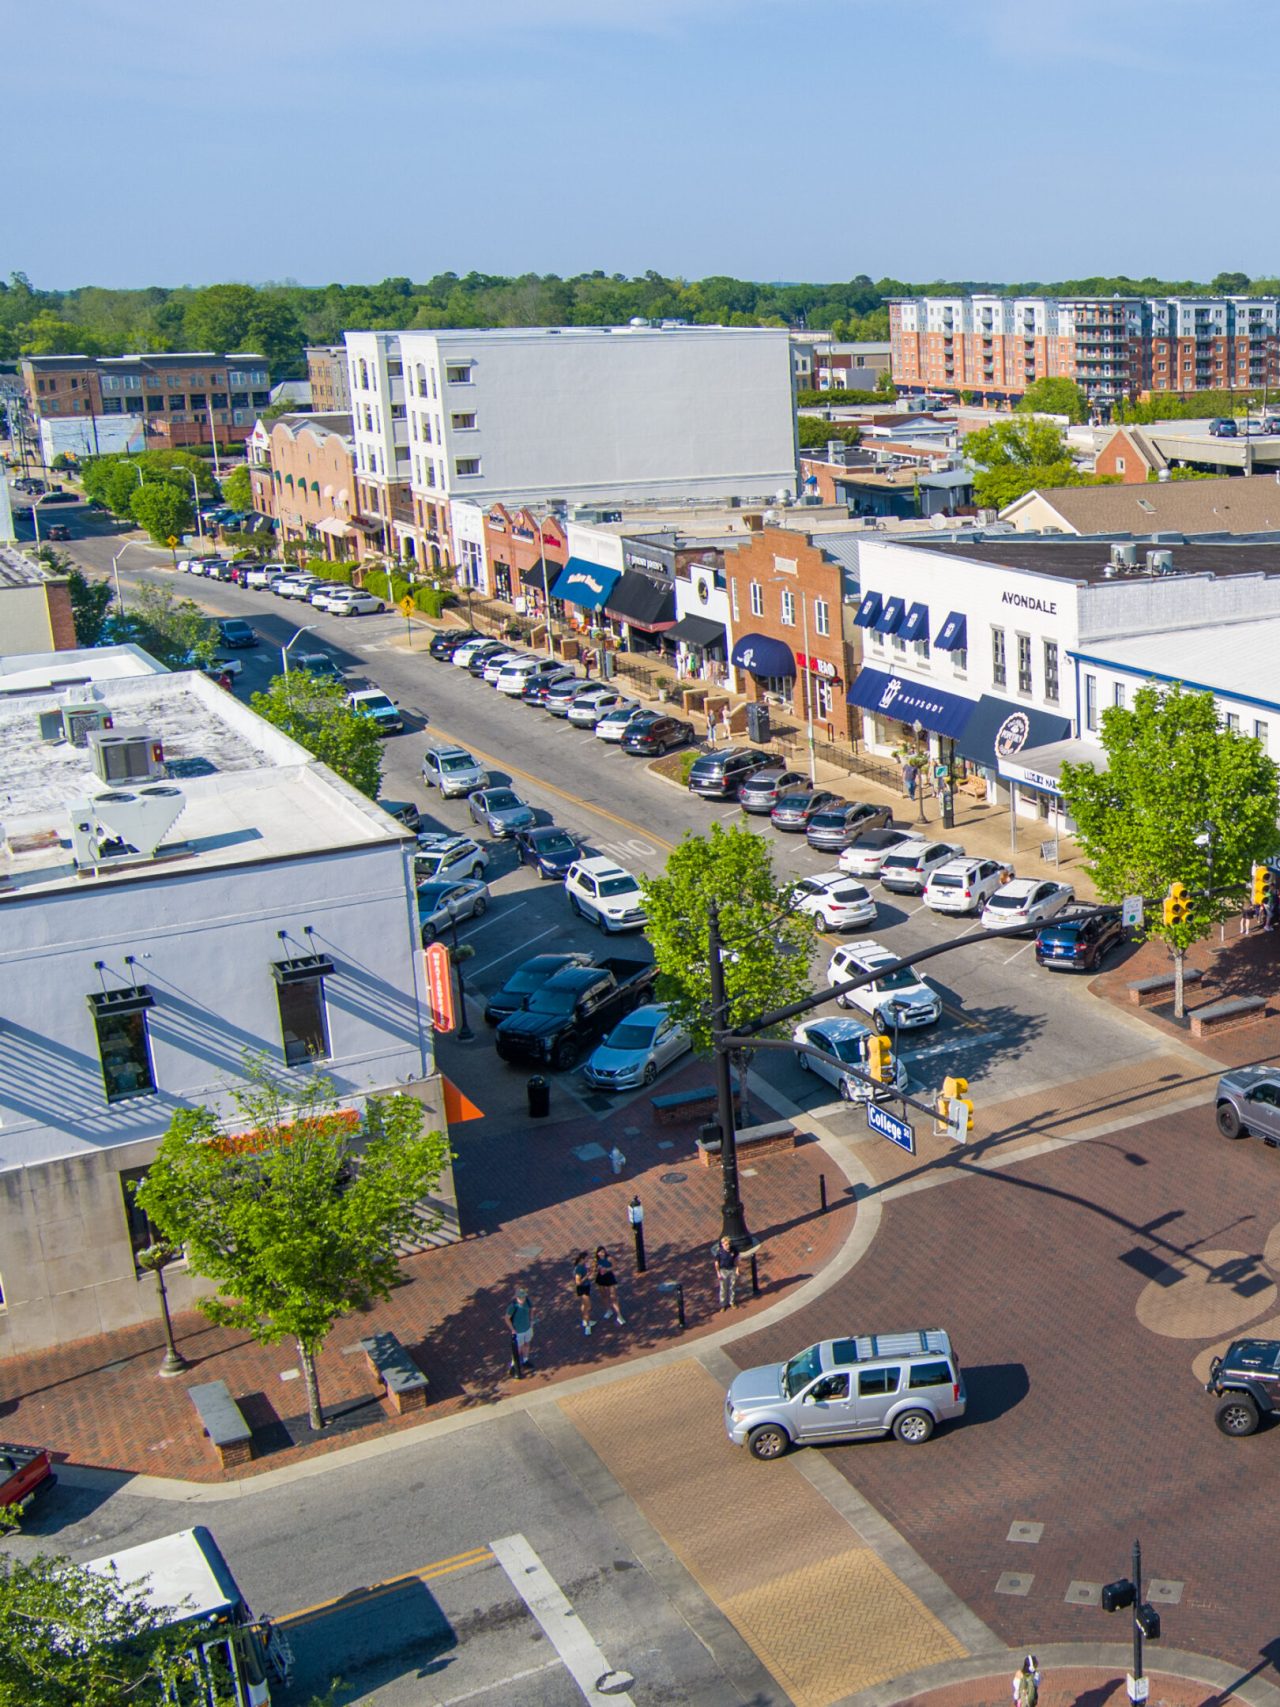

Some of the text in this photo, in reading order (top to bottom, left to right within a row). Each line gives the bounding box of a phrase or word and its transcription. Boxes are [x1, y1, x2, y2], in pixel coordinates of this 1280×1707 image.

[1001, 591, 1057, 615] AVONDALE
[594, 839, 656, 860] ONL
[870, 1107, 903, 1140] College
